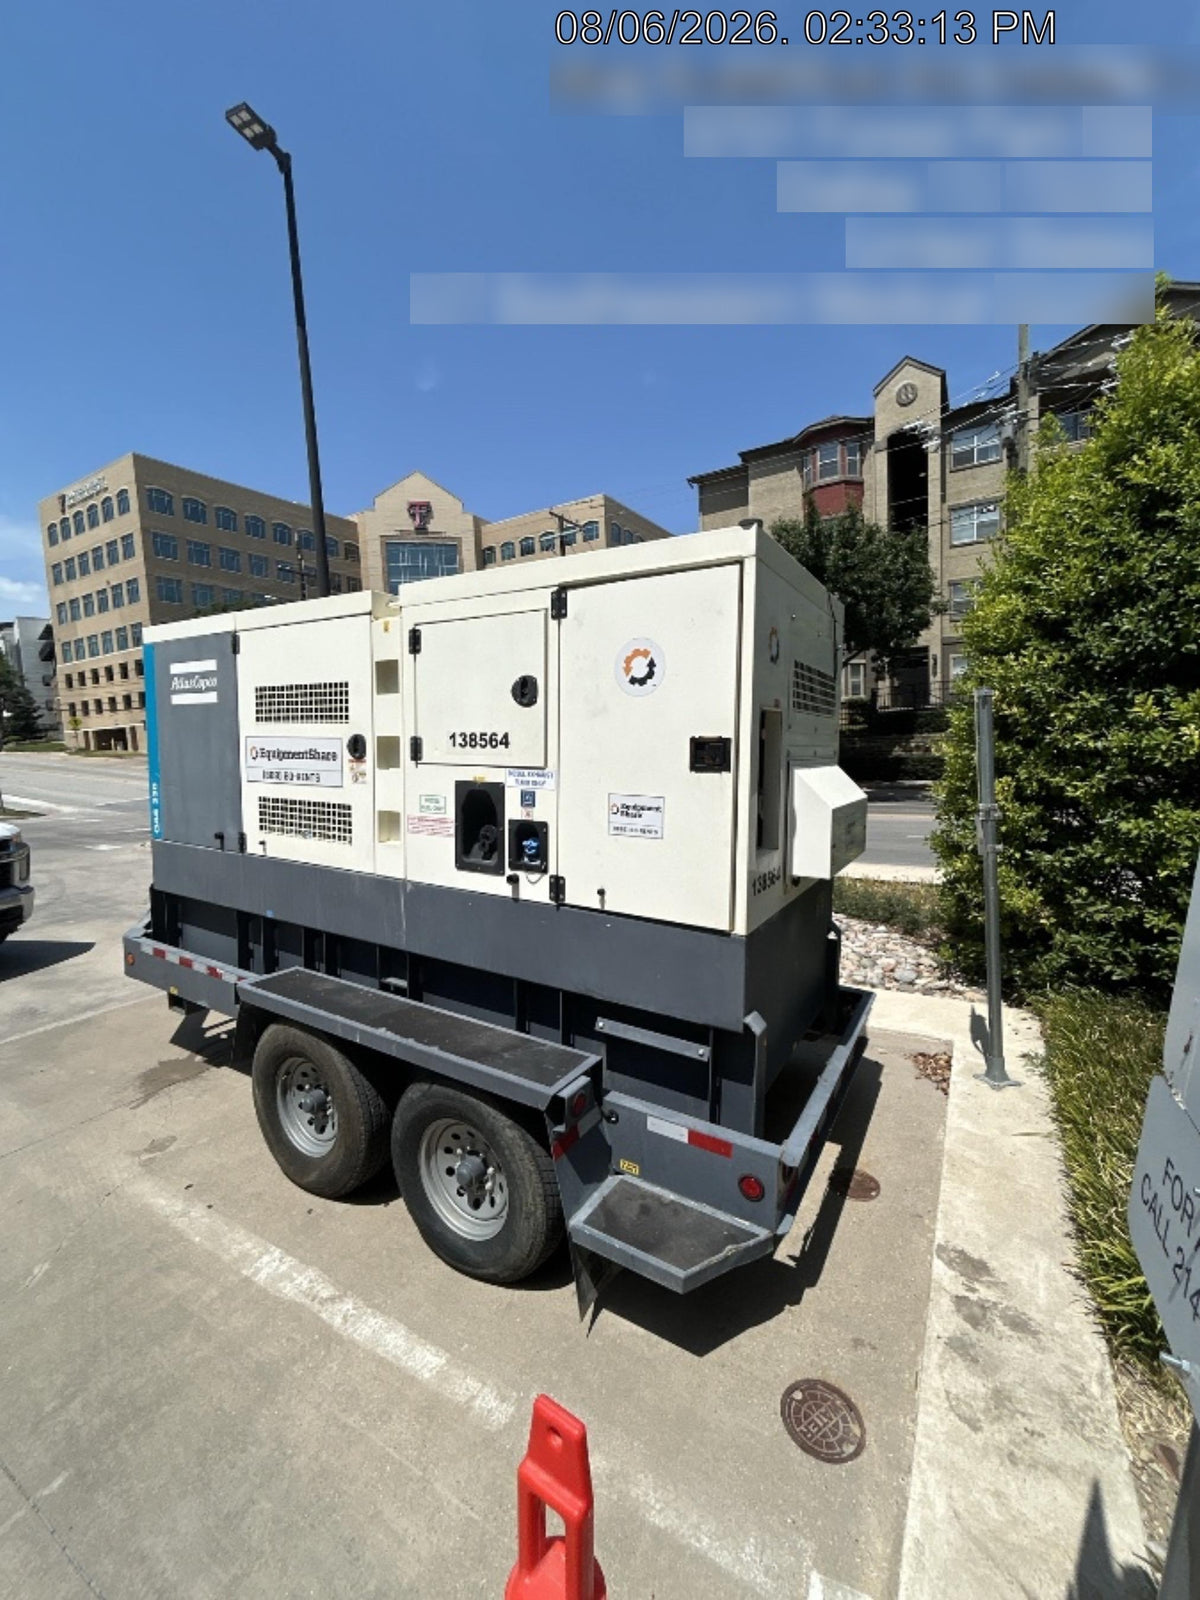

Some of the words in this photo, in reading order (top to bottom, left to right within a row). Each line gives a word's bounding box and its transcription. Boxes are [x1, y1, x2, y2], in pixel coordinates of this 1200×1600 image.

[449, 731, 510, 749] 138564
[1140, 1172, 1170, 1258] CALL
[1162, 1156, 1195, 1238] FOR
